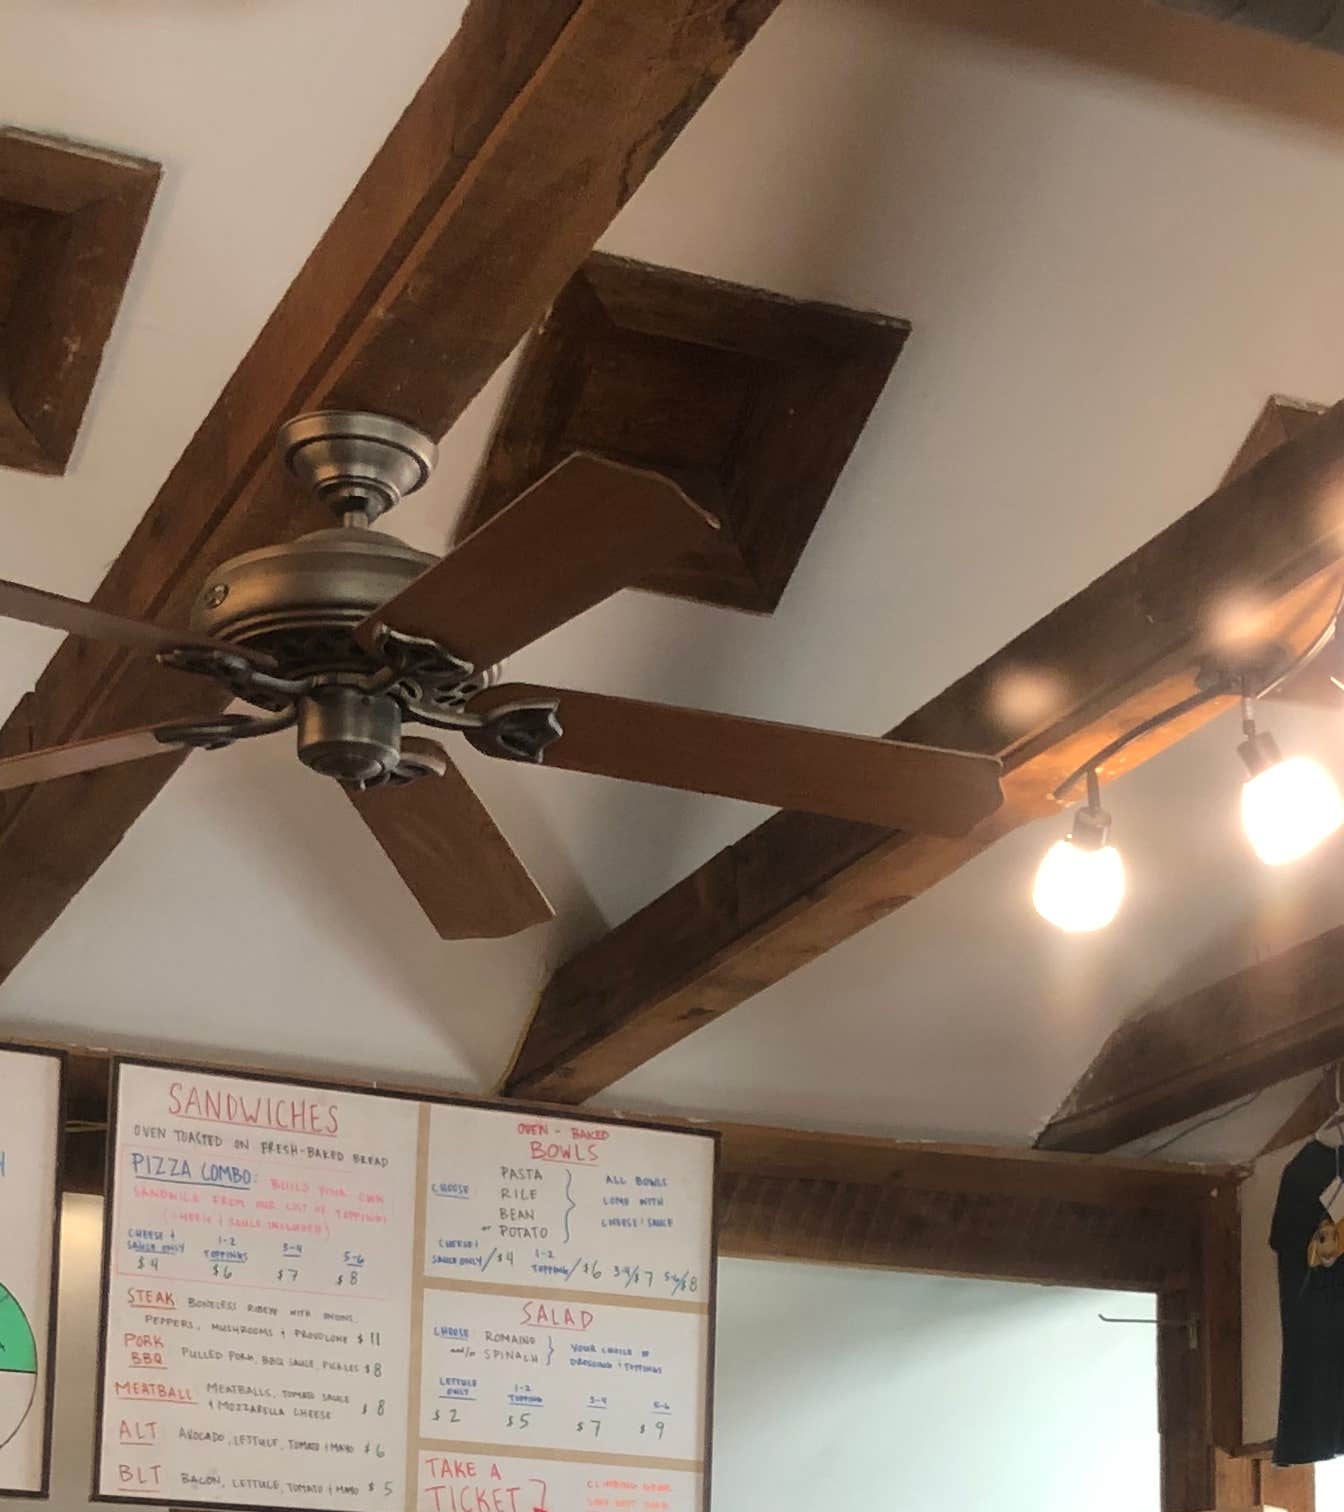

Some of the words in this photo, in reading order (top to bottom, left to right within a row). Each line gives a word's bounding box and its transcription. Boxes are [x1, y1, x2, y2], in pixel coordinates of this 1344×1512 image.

[168, 1081, 339, 1134] SANDWICHES
[571, 1127, 610, 1141] BAKED
[133, 1124, 166, 1139] OVEN
[173, 1129, 223, 1148] TOASTED
[233, 1137, 251, 1151] ON
[260, 1140, 345, 1163] FRESH-BAKED
[352, 1153, 389, 1169] BREAD
[529, 1140, 599, 1162] BOWLS
[131, 1151, 192, 1179] PIZZA
[500, 1166, 543, 1181] PASTA
[500, 1186, 537, 1201] RICE
[499, 1207, 535, 1221] BEAN
[499, 1224, 548, 1240] POTATO
[127, 1287, 176, 1307] STEAK
[520, 1301, 594, 1330] SALAD
[123, 1331, 165, 1349] PORK
[211, 1323, 274, 1338] MUSHROOMS
[484, 1330, 537, 1346] ROMAINE
[131, 1350, 164, 1366] BBQ
[482, 1348, 538, 1364] SPINACH
[114, 1378, 193, 1401] MEATBALL
[119, 1419, 158, 1440] ALT
[118, 1463, 161, 1485] BLT
[425, 1458, 477, 1479] TAKE
[490, 1462, 503, 1480] A
